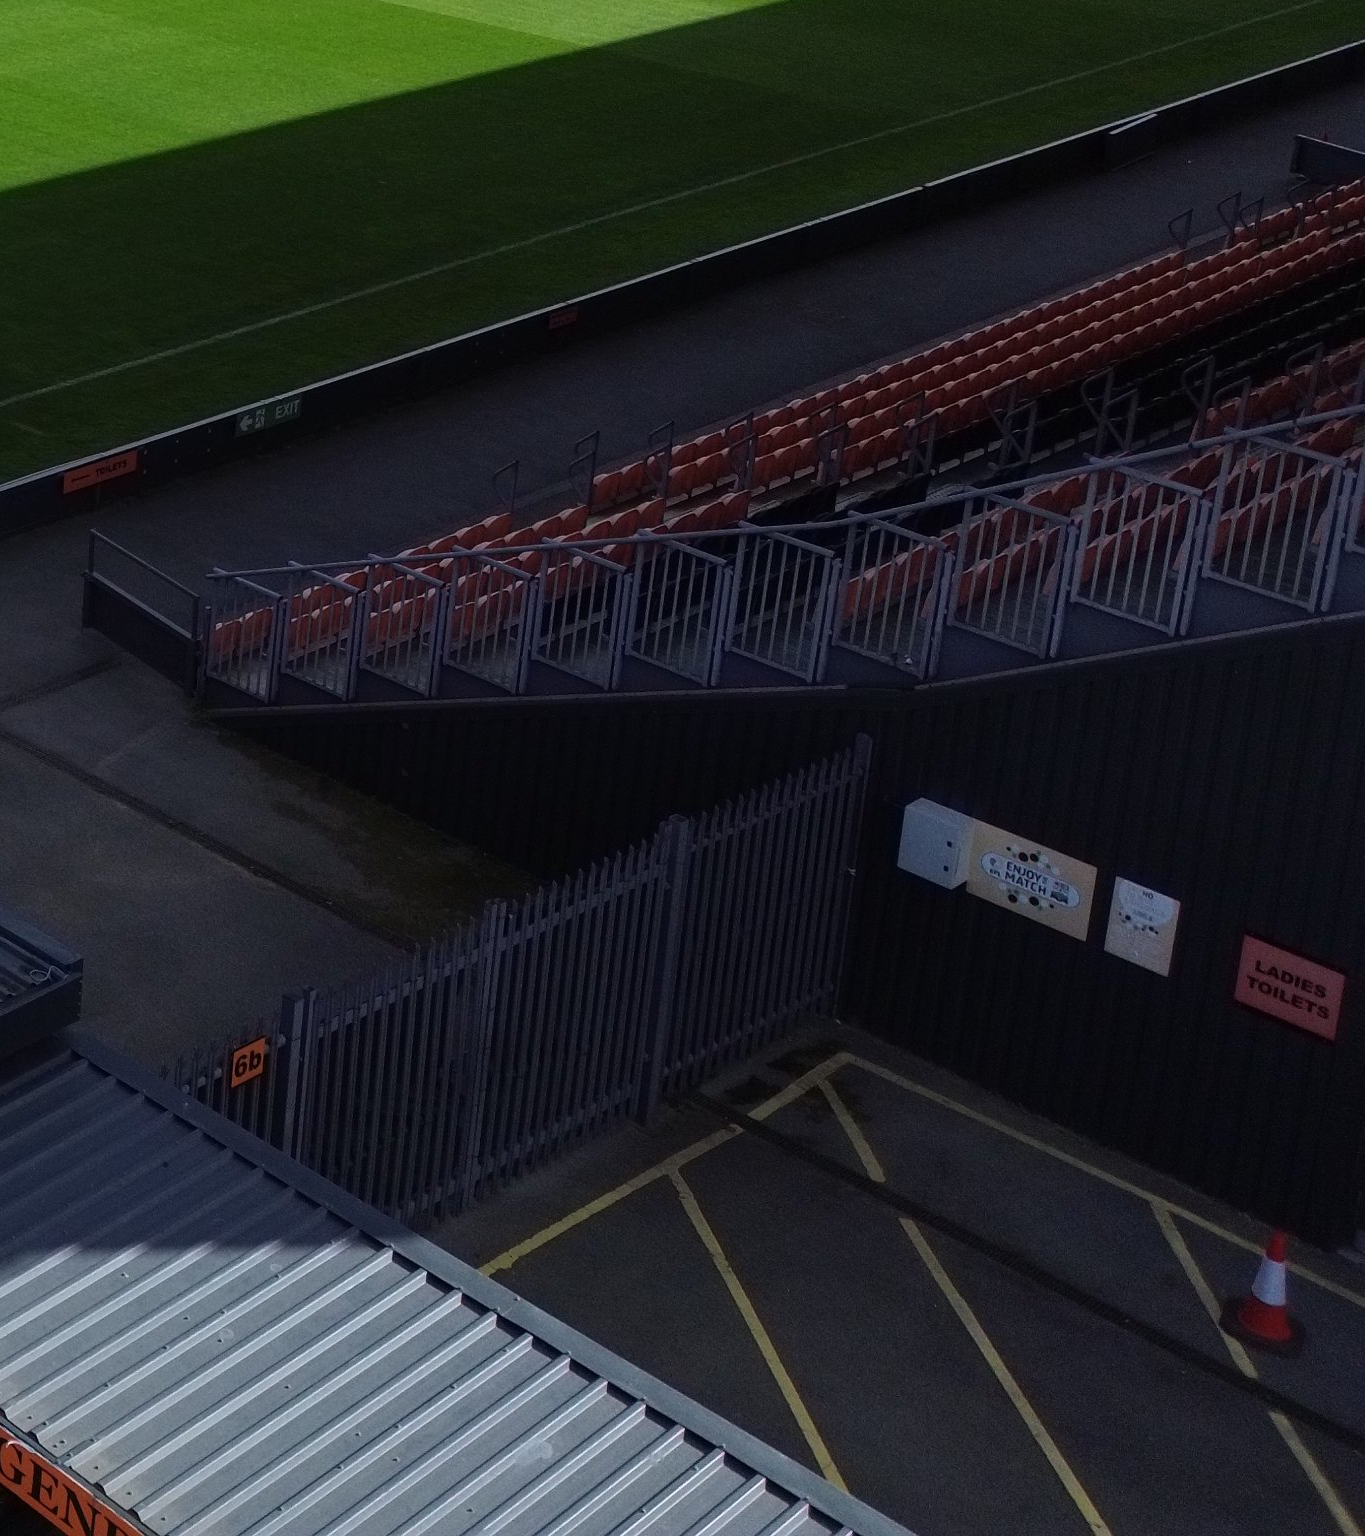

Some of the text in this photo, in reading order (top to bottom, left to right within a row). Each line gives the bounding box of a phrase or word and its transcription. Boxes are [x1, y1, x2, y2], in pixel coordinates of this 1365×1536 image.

[275, 398, 301, 419] EXIT
[95, 459, 128, 476] TOILETS
[1004, 871, 1047, 896] MATCH
[1006, 860, 1043, 883] ENJOY
[1254, 959, 1327, 999] LADIES
[1246, 974, 1330, 1020] TOILETS
[234, 1049, 263, 1078] 6b
